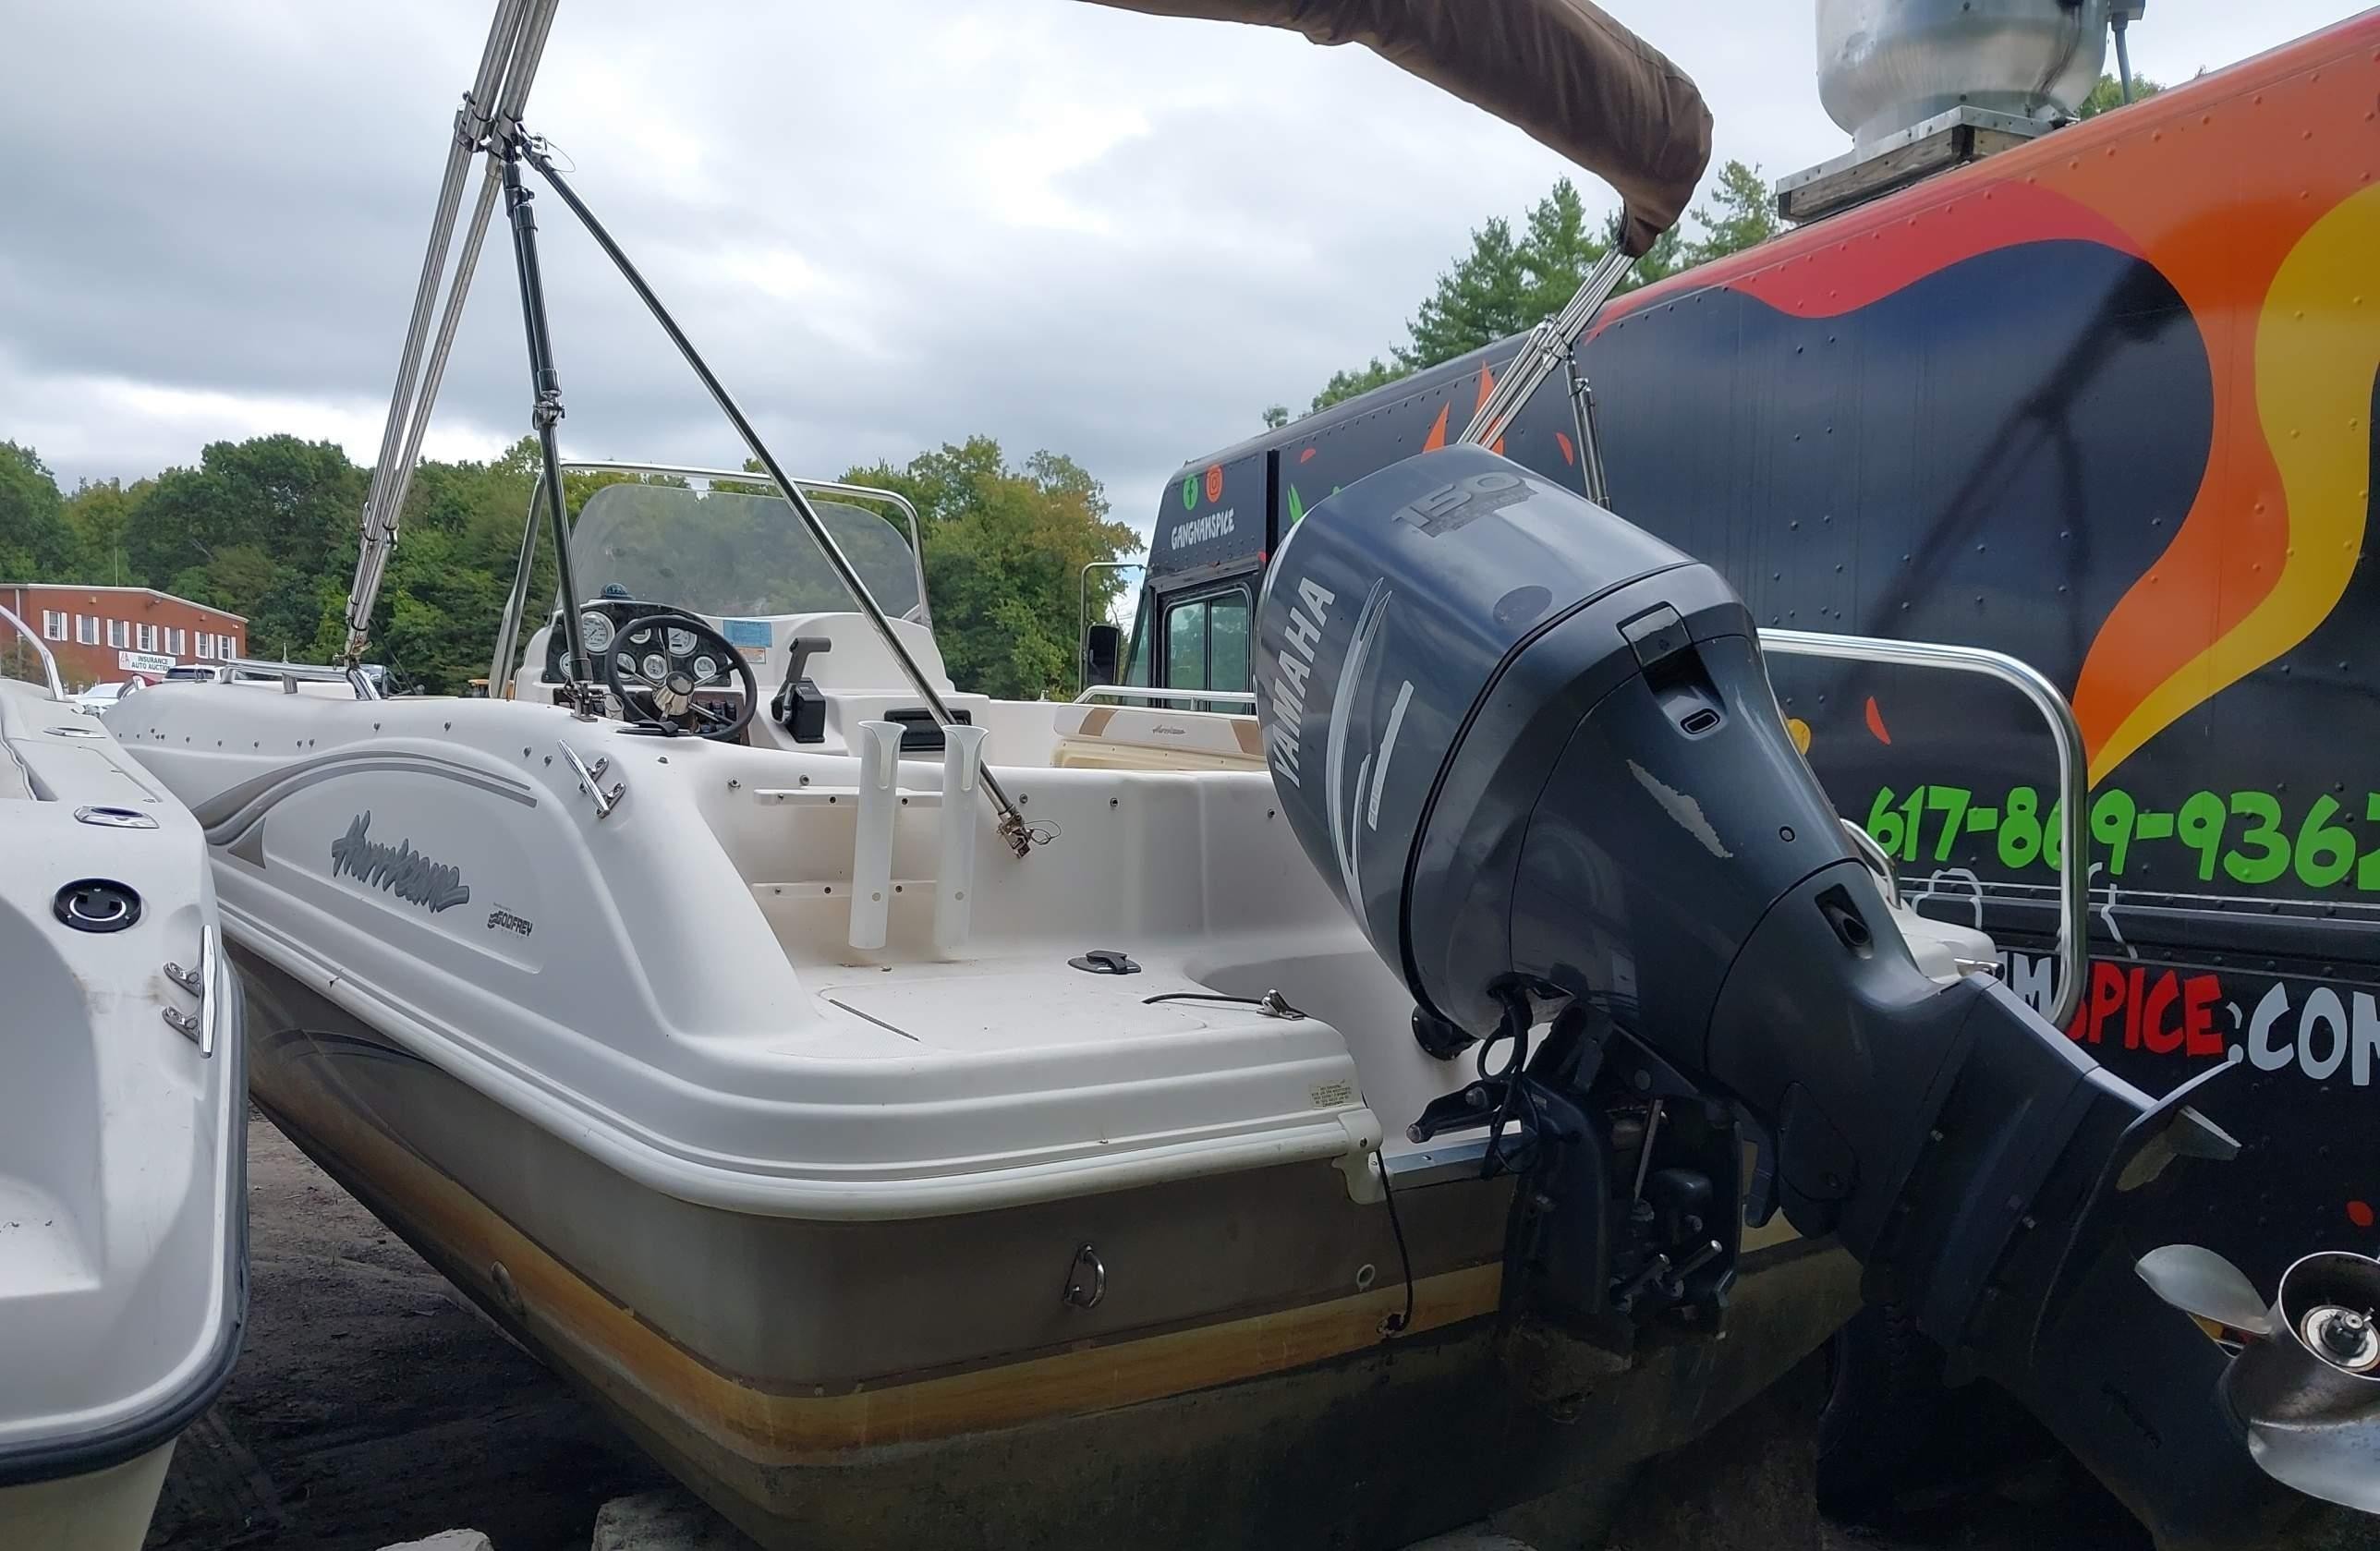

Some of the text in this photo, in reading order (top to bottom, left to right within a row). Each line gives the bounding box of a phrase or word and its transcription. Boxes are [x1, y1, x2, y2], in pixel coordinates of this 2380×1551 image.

[1171, 508, 1235, 551] GANGNAMSPICE
[138, 656, 169, 665] INSURANCE
[1272, 576, 1336, 789] YAMAHA
[491, 910, 533, 937] GODFREY
